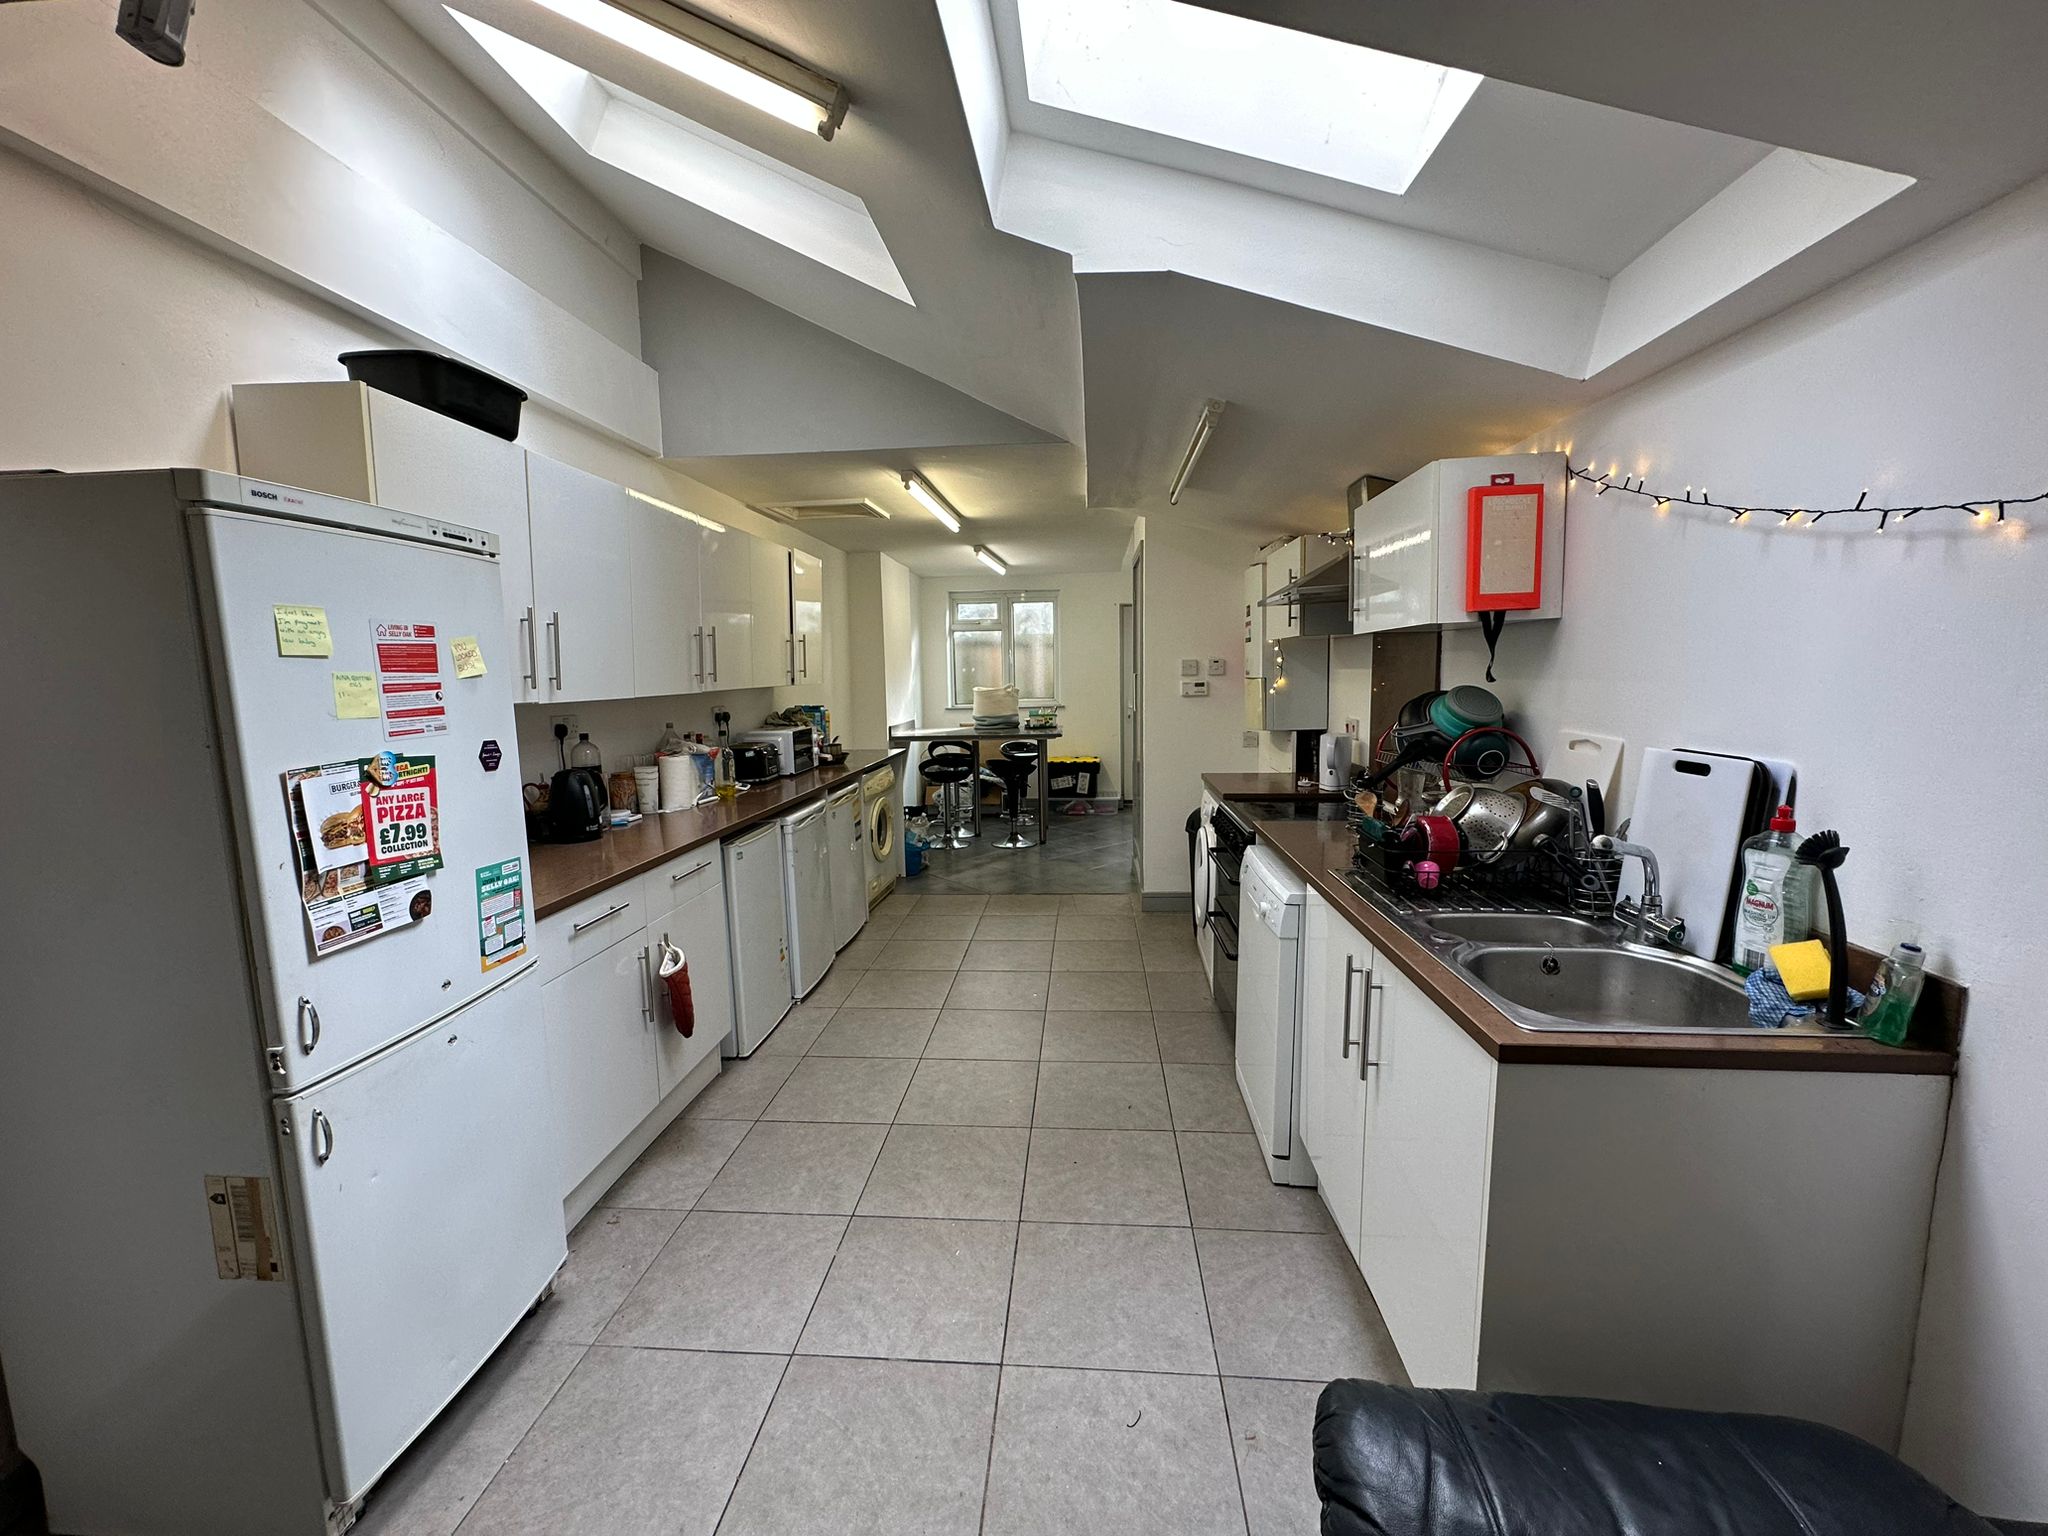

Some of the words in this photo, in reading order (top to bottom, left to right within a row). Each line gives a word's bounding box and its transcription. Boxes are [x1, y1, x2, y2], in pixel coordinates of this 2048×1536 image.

[251, 490, 278, 500] BOSCH
[398, 766, 428, 778] RTNIGHT!
[376, 795, 394, 805] ANY
[397, 793, 425, 804] LARGE
[376, 803, 426, 823] PIZZA
[380, 823, 427, 845] £7.99
[381, 840, 428, 854] COLLECTION
[481, 880, 502, 893] SELLY
[1746, 898, 1774, 911] MAGNUM
